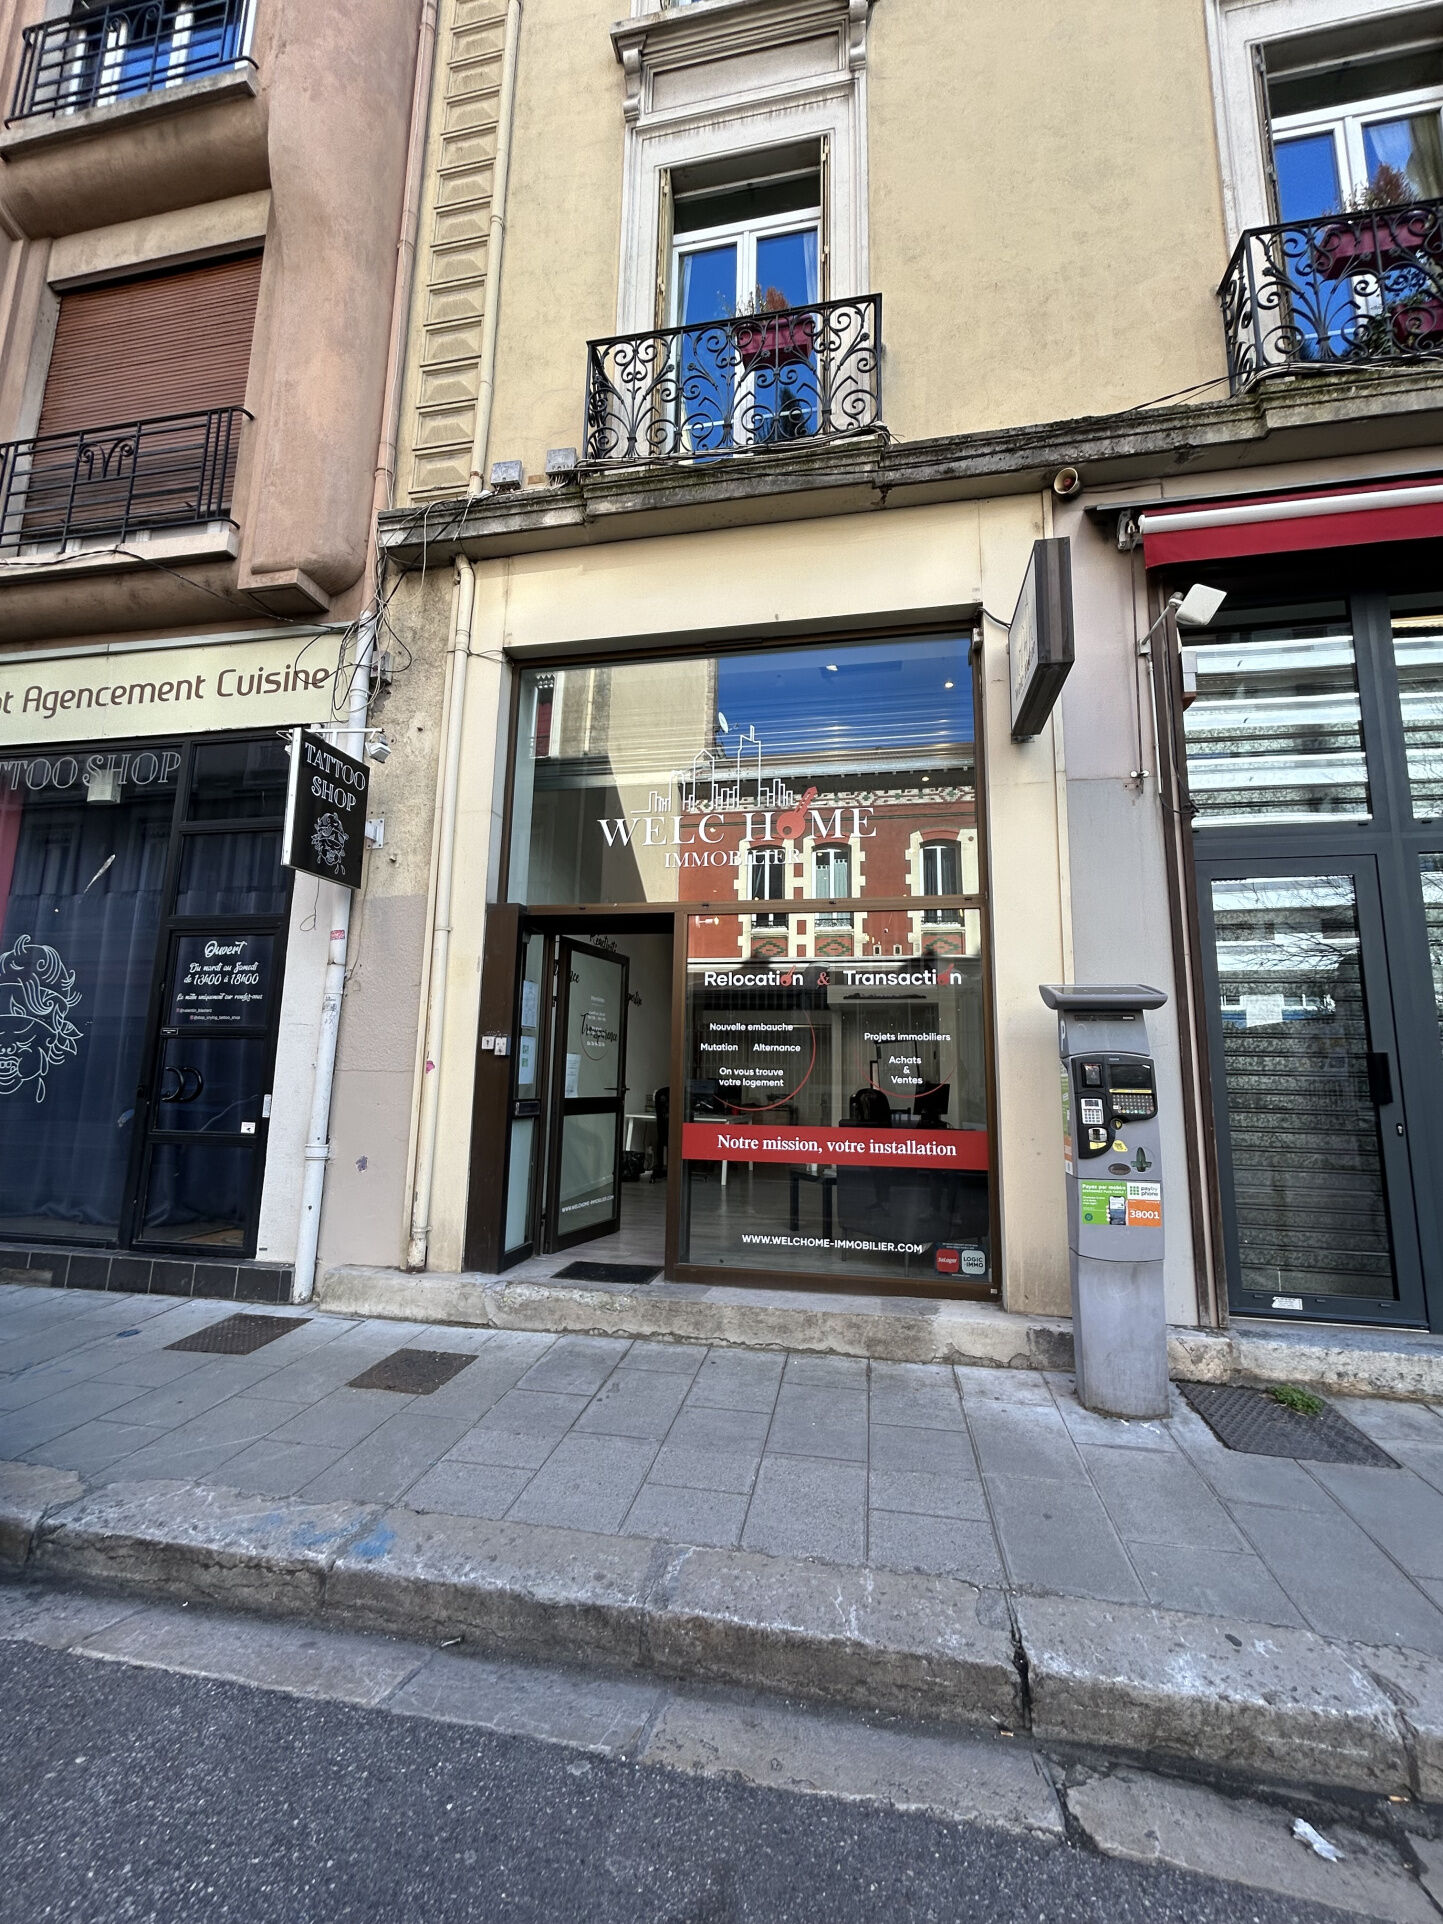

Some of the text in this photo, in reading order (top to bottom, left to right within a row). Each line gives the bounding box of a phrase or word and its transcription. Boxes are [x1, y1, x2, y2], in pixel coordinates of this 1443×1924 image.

[22, 674, 206, 719] Agencement
[216, 664, 330, 697] Cuisine
[82, 752, 182, 788] SHOP
[304, 742, 366, 791] TATTOO
[310, 775, 357, 812] SHOP
[597, 813, 725, 848] WELC
[664, 848, 802, 868] IMMOBILIER
[204, 940, 248, 958] Ouvert
[189, 962, 201, 973] Du
[203, 962, 223, 972] mardi
[233, 961, 259, 973] Samedi
[183, 974, 193, 983] de
[230, 973, 259, 985] 18h00
[704, 967, 962, 987] Relocation & Transaction
[709, 1022, 794, 1032] Nouvelle embauche
[864, 1032, 951, 1043] Projets immobiliers
[700, 1042, 739, 1052] Mutation
[752, 1043, 801, 1052] Alternance
[888, 1056, 922, 1065] Achats
[719, 1067, 732, 1076] On
[755, 1068, 784, 1077] trouve
[902, 1065, 911, 1075] &
[718, 1077, 784, 1088] votre logement
[890, 1075, 923, 1085] Ventes
[717, 1134, 958, 1157] Notre mission, votre installation
[1129, 1209, 1160, 1220] 38001
[741, 1234, 923, 1254] WWW.WELCHOME-IMMOBILIER.COM
